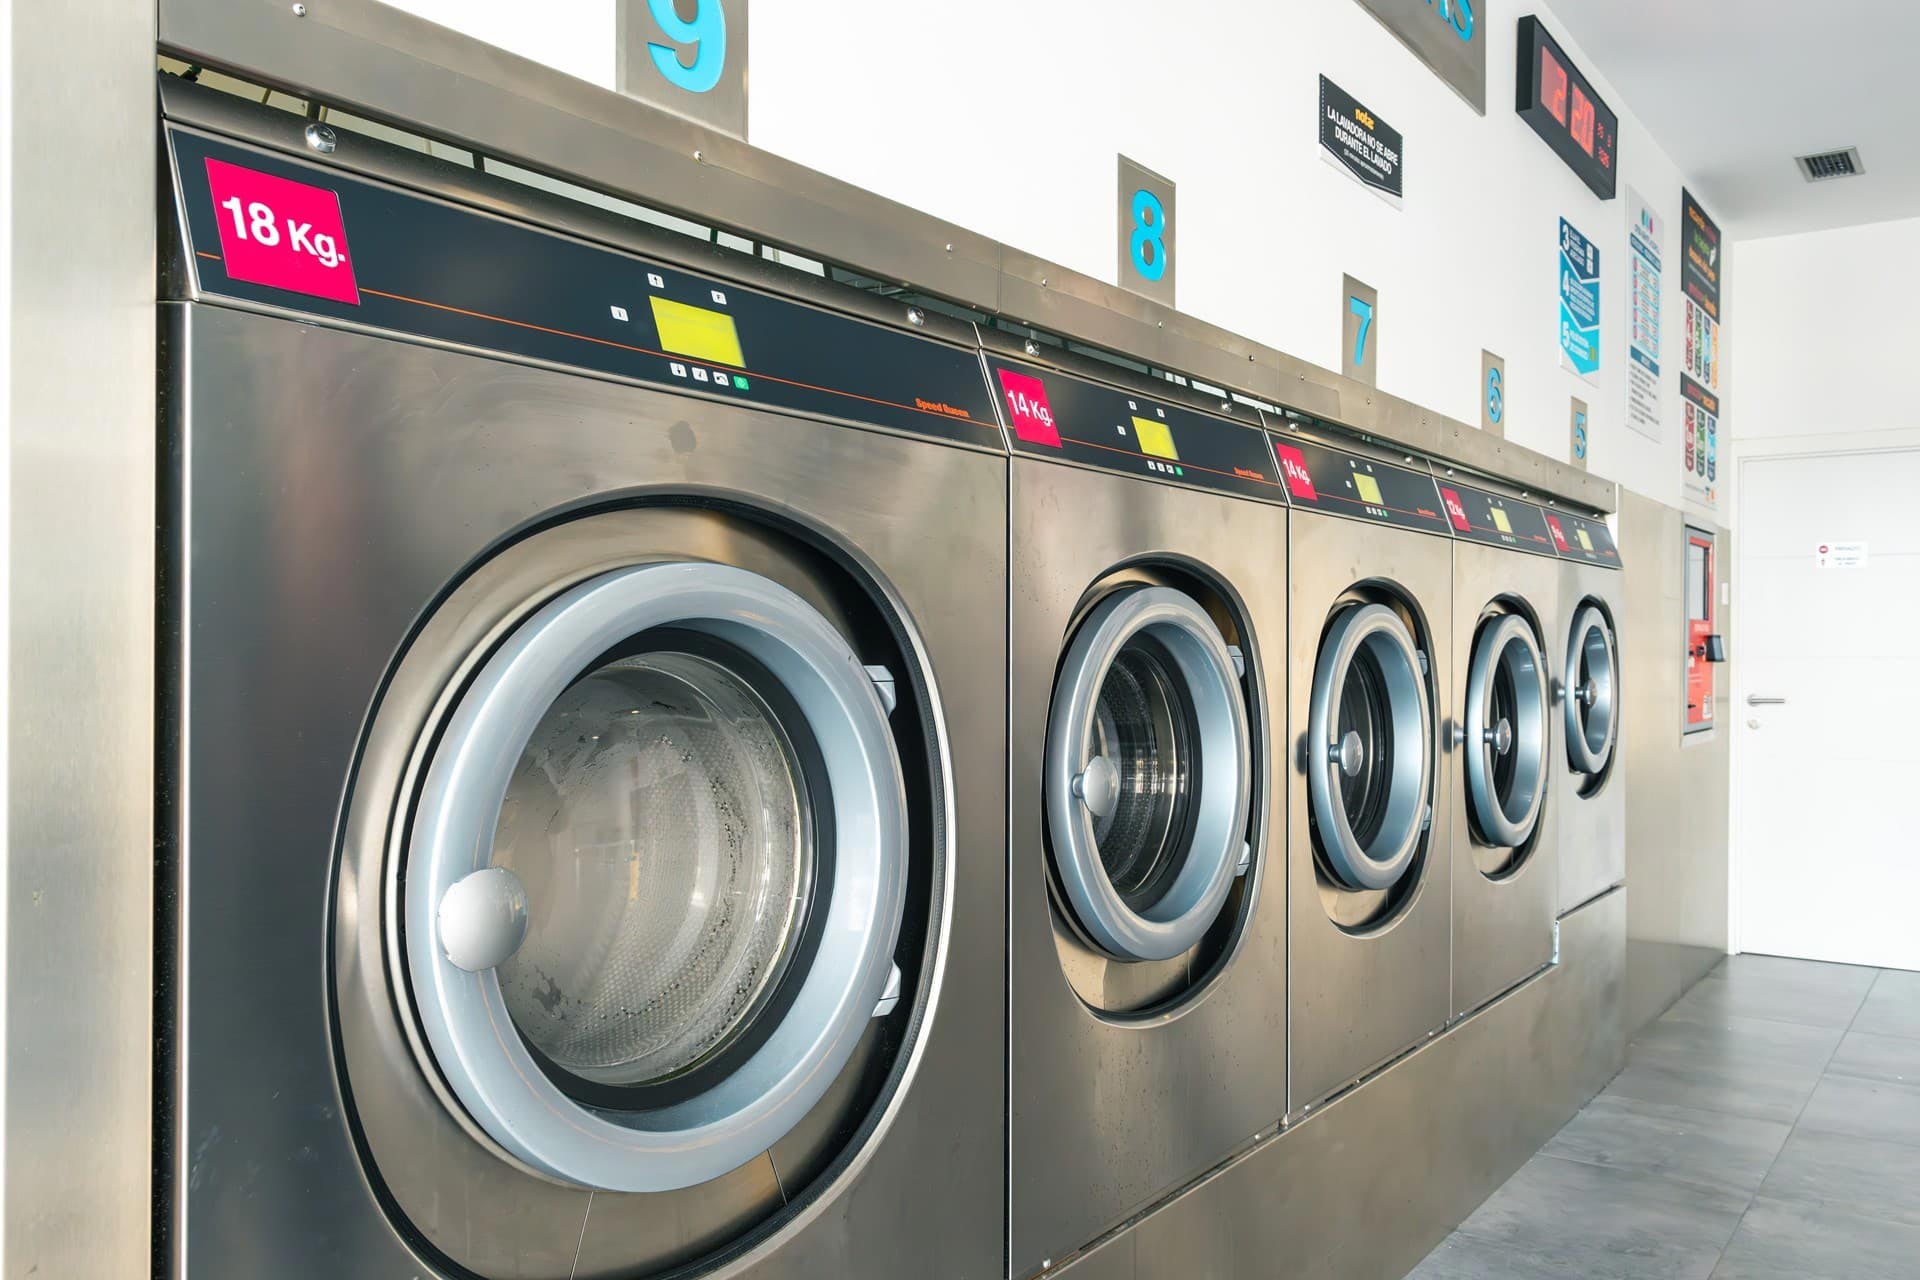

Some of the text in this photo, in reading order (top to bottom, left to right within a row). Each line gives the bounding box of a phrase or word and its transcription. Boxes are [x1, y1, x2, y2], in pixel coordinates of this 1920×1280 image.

[645, 0, 726, 93] 9
[1327, 105, 1337, 121] LA
[1336, 111, 1367, 141] LAVADORA
[1366, 133, 1376, 149] NO
[1375, 141, 1385, 156] SE
[1383, 145, 1399, 167] ABRE
[1335, 126, 1363, 155] DURANTE
[1362, 143, 1372, 161] EL
[1371, 150, 1392, 174] LAVADO
[222, 196, 346, 268] 18 Kg.
[1130, 188, 1167, 281] 8
[1562, 224, 1570, 251] 3
[1350, 295, 1373, 366] 7
[915, 398, 943, 412] Speed
[1007, 389, 1054, 428] 14 Kg.
[1487, 367, 1502, 424] 6
[1575, 411, 1586, 460] 5
[1283, 459, 1297, 478] 14
